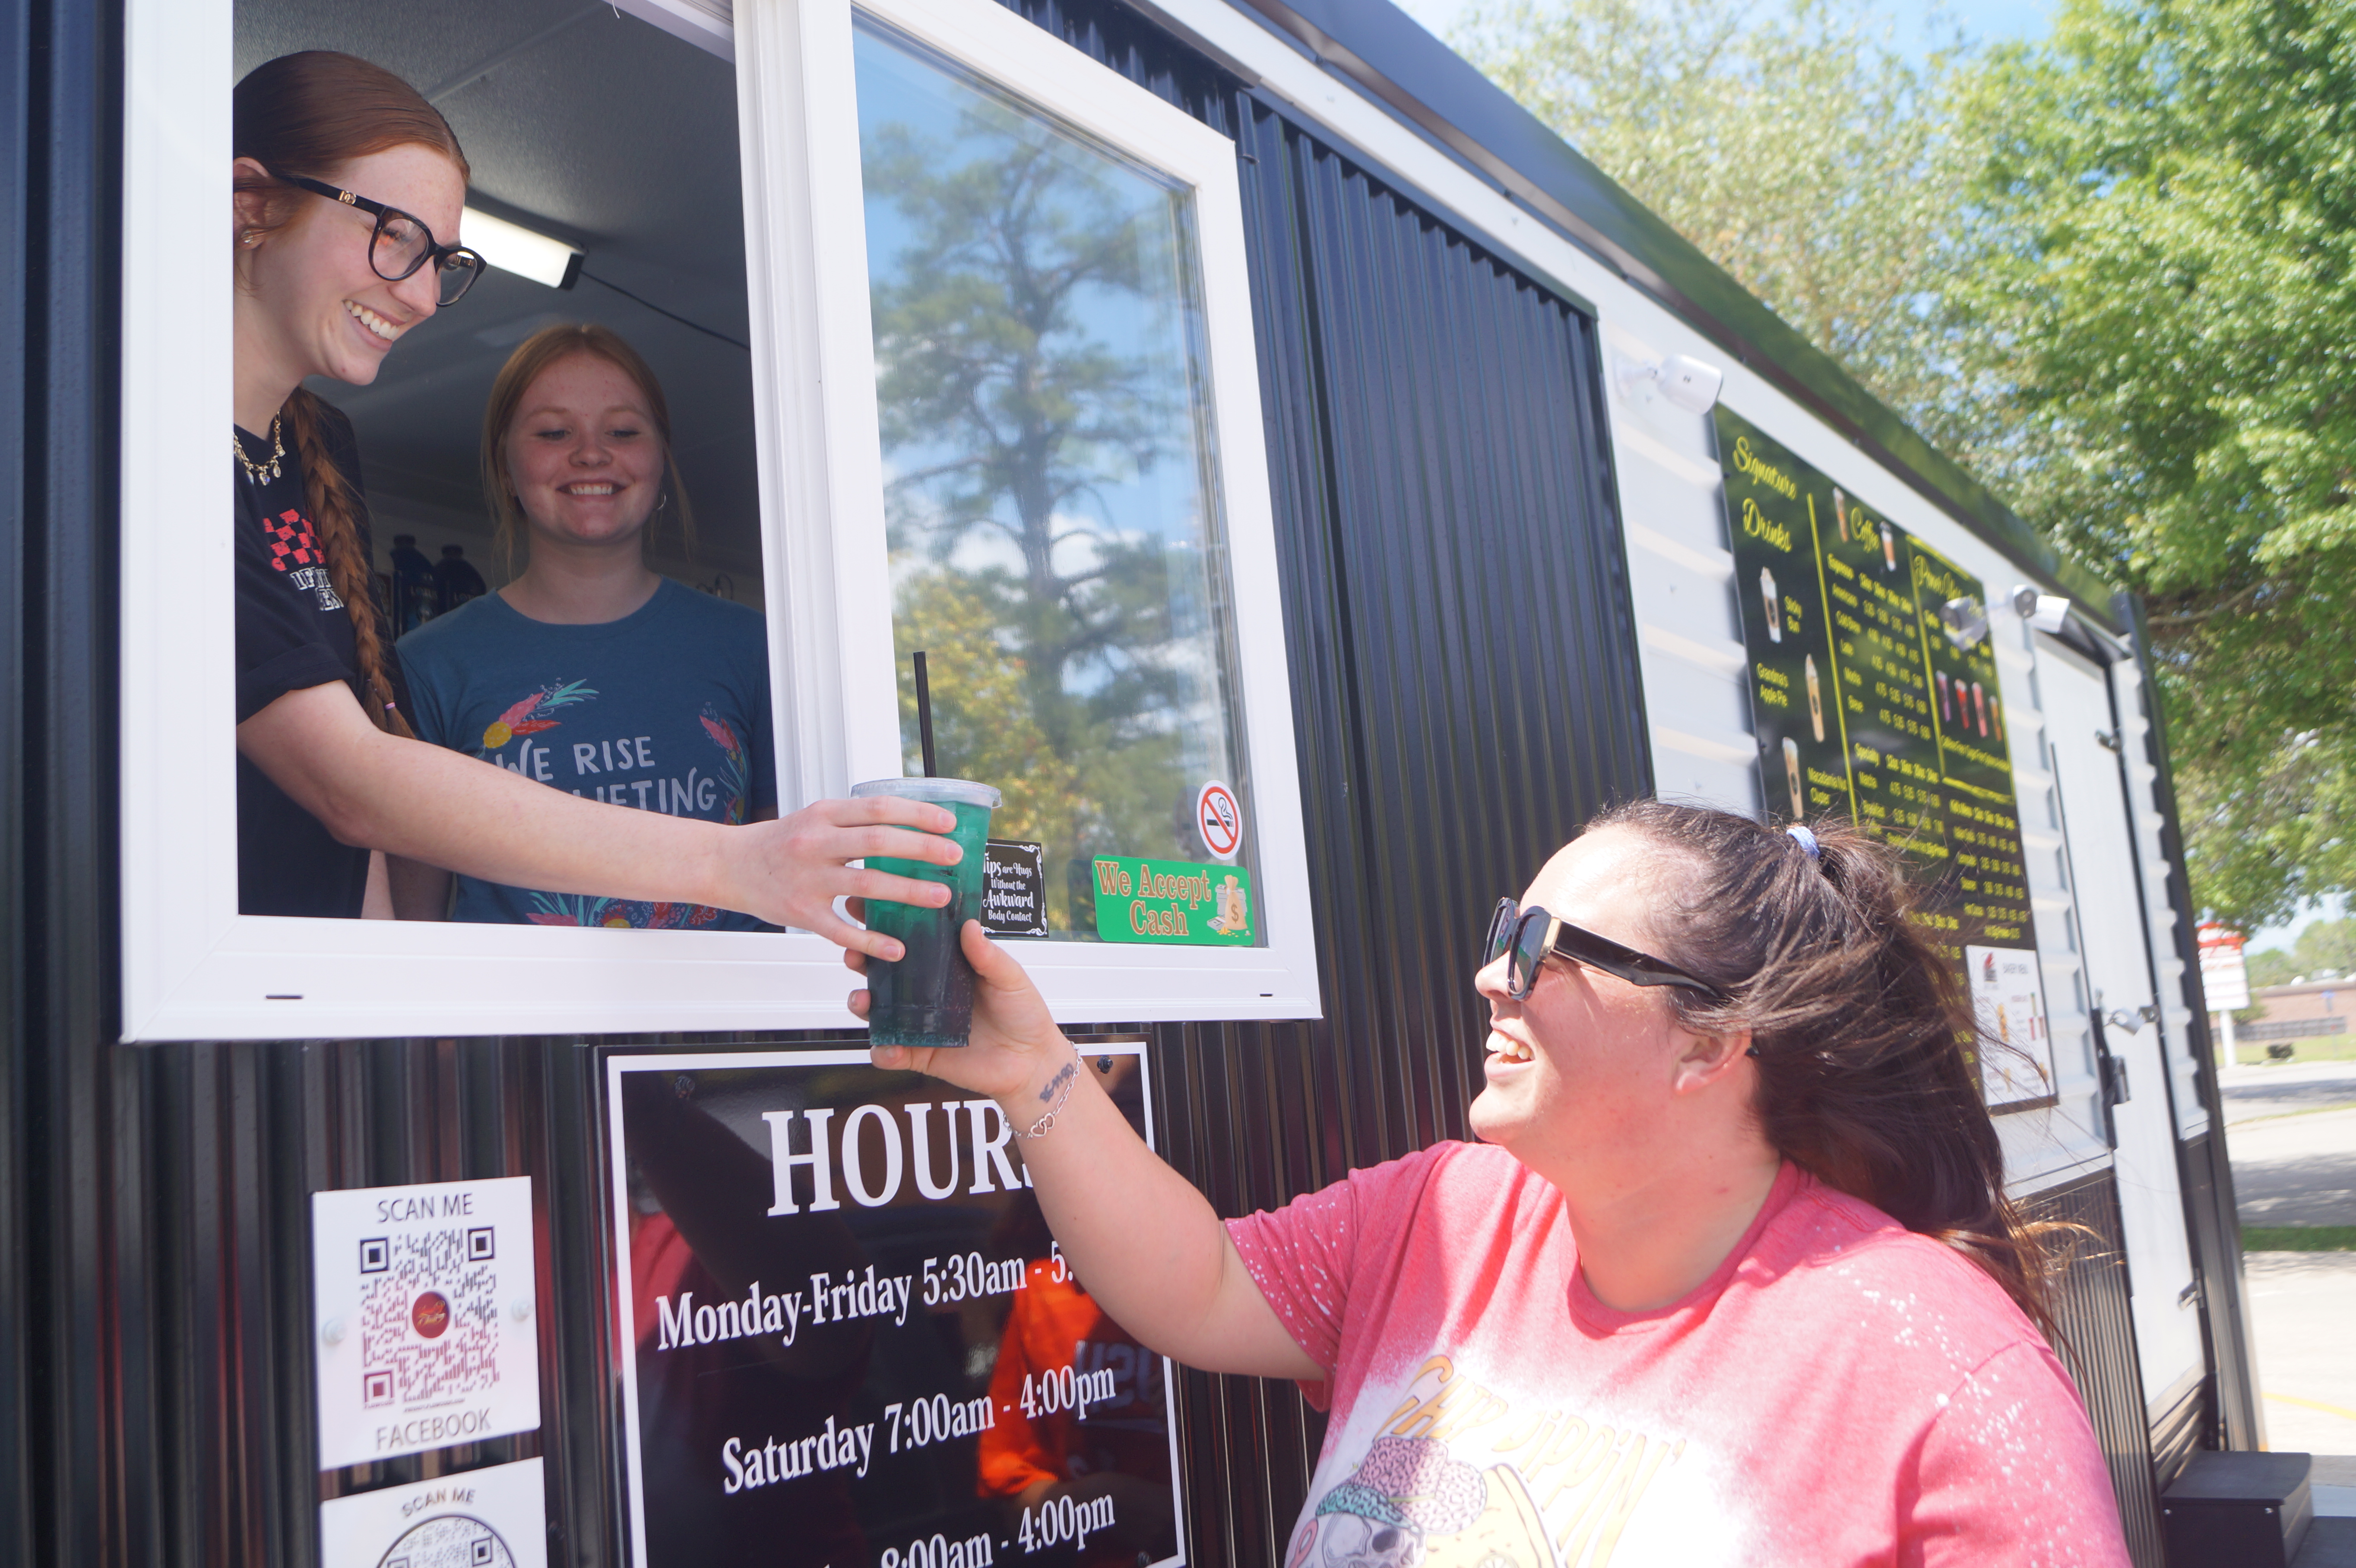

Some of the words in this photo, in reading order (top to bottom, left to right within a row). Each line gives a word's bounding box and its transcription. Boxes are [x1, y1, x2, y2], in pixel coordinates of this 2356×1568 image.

[1732, 436, 1797, 499] Signature
[1742, 497, 1792, 552] Drinks
[1850, 506, 1880, 553] Coffee
[1827, 553, 1854, 579] Espresso
[1784, 595, 1802, 618] Sticky
[1787, 615, 1800, 633] Bun
[1757, 662, 1789, 688] Grandma's
[1760, 684, 1777, 704] Apple
[1775, 689, 1788, 707] Pie
[496, 738, 553, 781] WE
[573, 736, 656, 775] RISE
[991, 878, 1016, 891] Without
[1016, 879, 1026, 891] the
[1002, 866, 1013, 874] are
[1013, 863, 1032, 878] Hugs
[1095, 860, 1131, 897] We
[1138, 864, 1211, 910] Accept
[982, 890, 1034, 909] Awkward
[988, 909, 1005, 924] Body
[1006, 910, 1032, 923] Contact
[1130, 901, 1189, 936] Cash
[377, 1195, 437, 1224] SCAN
[442, 1192, 474, 1217] ME
[656, 1268, 912, 1351] Monday-Friday
[923, 1251, 1027, 1306] 5:30am
[376, 1408, 491, 1451] FACEBOOK
[722, 1415, 874, 1494] Saturday
[884, 1393, 995, 1454] 7:00am
[1020, 1365, 1116, 1419] 4:00pm
[402, 1489, 447, 1517] SCAN
[451, 1488, 476, 1504] ME
[1018, 1494, 1115, 1554] 4:00pm
